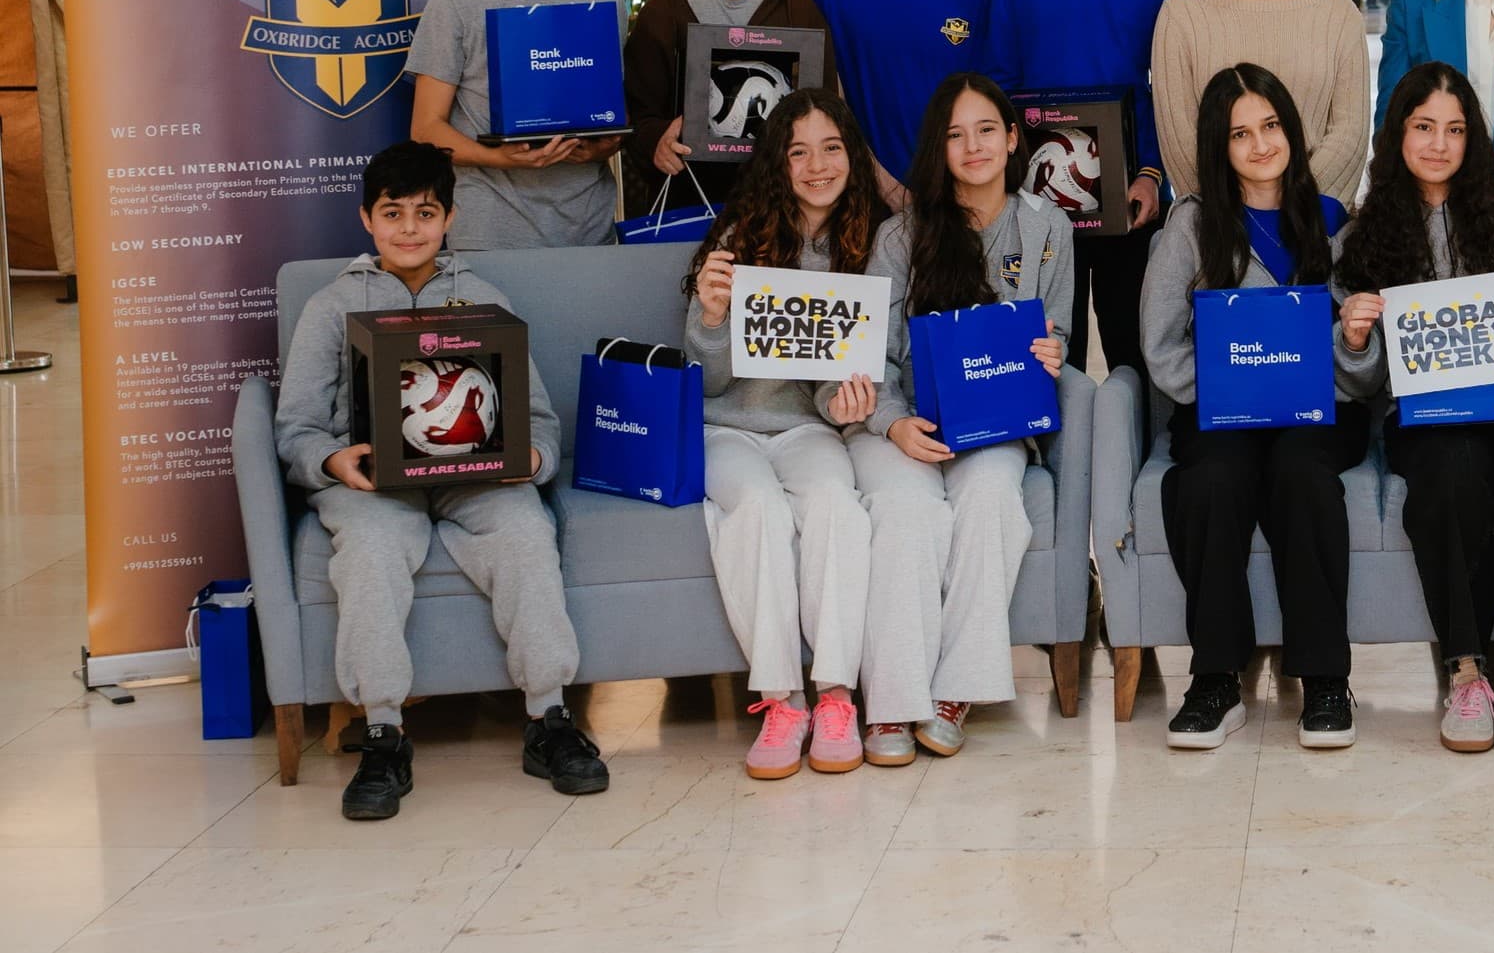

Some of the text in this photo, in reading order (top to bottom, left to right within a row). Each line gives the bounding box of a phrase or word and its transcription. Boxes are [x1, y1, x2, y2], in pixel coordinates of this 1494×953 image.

[253, 28, 341, 50] OXBRIDGE
[530, 48, 560, 59] Bank
[531, 57, 593, 71] Respublika
[111, 123, 201, 139] WE OFFER
[708, 144, 752, 153] WE ARE
[108, 156, 372, 178] EDEXCEL INTERNATIONAL PRIMARY
[110, 184, 146, 194] Provide
[150, 183, 192, 192] seamless
[196, 179, 252, 191] progression
[255, 178, 276, 186] from
[280, 175, 315, 187] Primary
[319, 175, 328, 183] to
[331, 173, 347, 182] the
[110, 183, 356, 205] General Certificate of Secondary Education (IGCSE)
[122, 206, 148, 215] Years
[161, 203, 199, 215] through
[112, 235, 243, 251] LOW SECONDARY
[112, 277, 157, 288] IGCSE
[114, 297, 130, 305] The
[134, 292, 196, 304] International
[200, 290, 237, 299] General
[113, 306, 151, 317] (IGCSE)
[186, 303, 196, 311] of
[199, 302, 215, 310] the
[218, 301, 239, 309] best
[242, 299, 272, 308] known
[745, 294, 869, 321] GLOBAL
[114, 320, 129, 328] the
[133, 318, 164, 326] means
[168, 316, 177, 324] to
[181, 314, 207, 323] enter
[210, 313, 235, 323] many
[745, 316, 858, 339] MONEY
[744, 337, 835, 360] WEEK
[1230, 342, 1263, 352] Bank
[116, 352, 178, 364] A LEVEL
[962, 354, 992, 369] Bank
[1231, 352, 1301, 366] Respublika
[116, 359, 273, 376] Available in 19 popular subjects,
[965, 362, 1025, 380] Respublika
[183, 373, 214, 383] GCSEs
[218, 372, 235, 380] and
[239, 370, 255, 378] can
[117, 390, 132, 399] for
[144, 387, 167, 396] wide
[170, 384, 213, 395] selection
[217, 383, 226, 391] of
[118, 397, 212, 410] and career success.
[596, 405, 619, 419] Bank
[596, 417, 647, 435] Respublika
[120, 434, 159, 446] BTEC
[121, 452, 138, 461] The
[142, 451, 163, 461] high
[167, 448, 202, 459] quality,
[122, 458, 231, 473] of work. BTEC courses
[405, 461, 503, 476] WE ARE SABAH
[131, 475, 159, 484] range
[162, 473, 172, 481] of
[175, 469, 216, 481] subjects
[123, 533, 177, 546] CALL US
